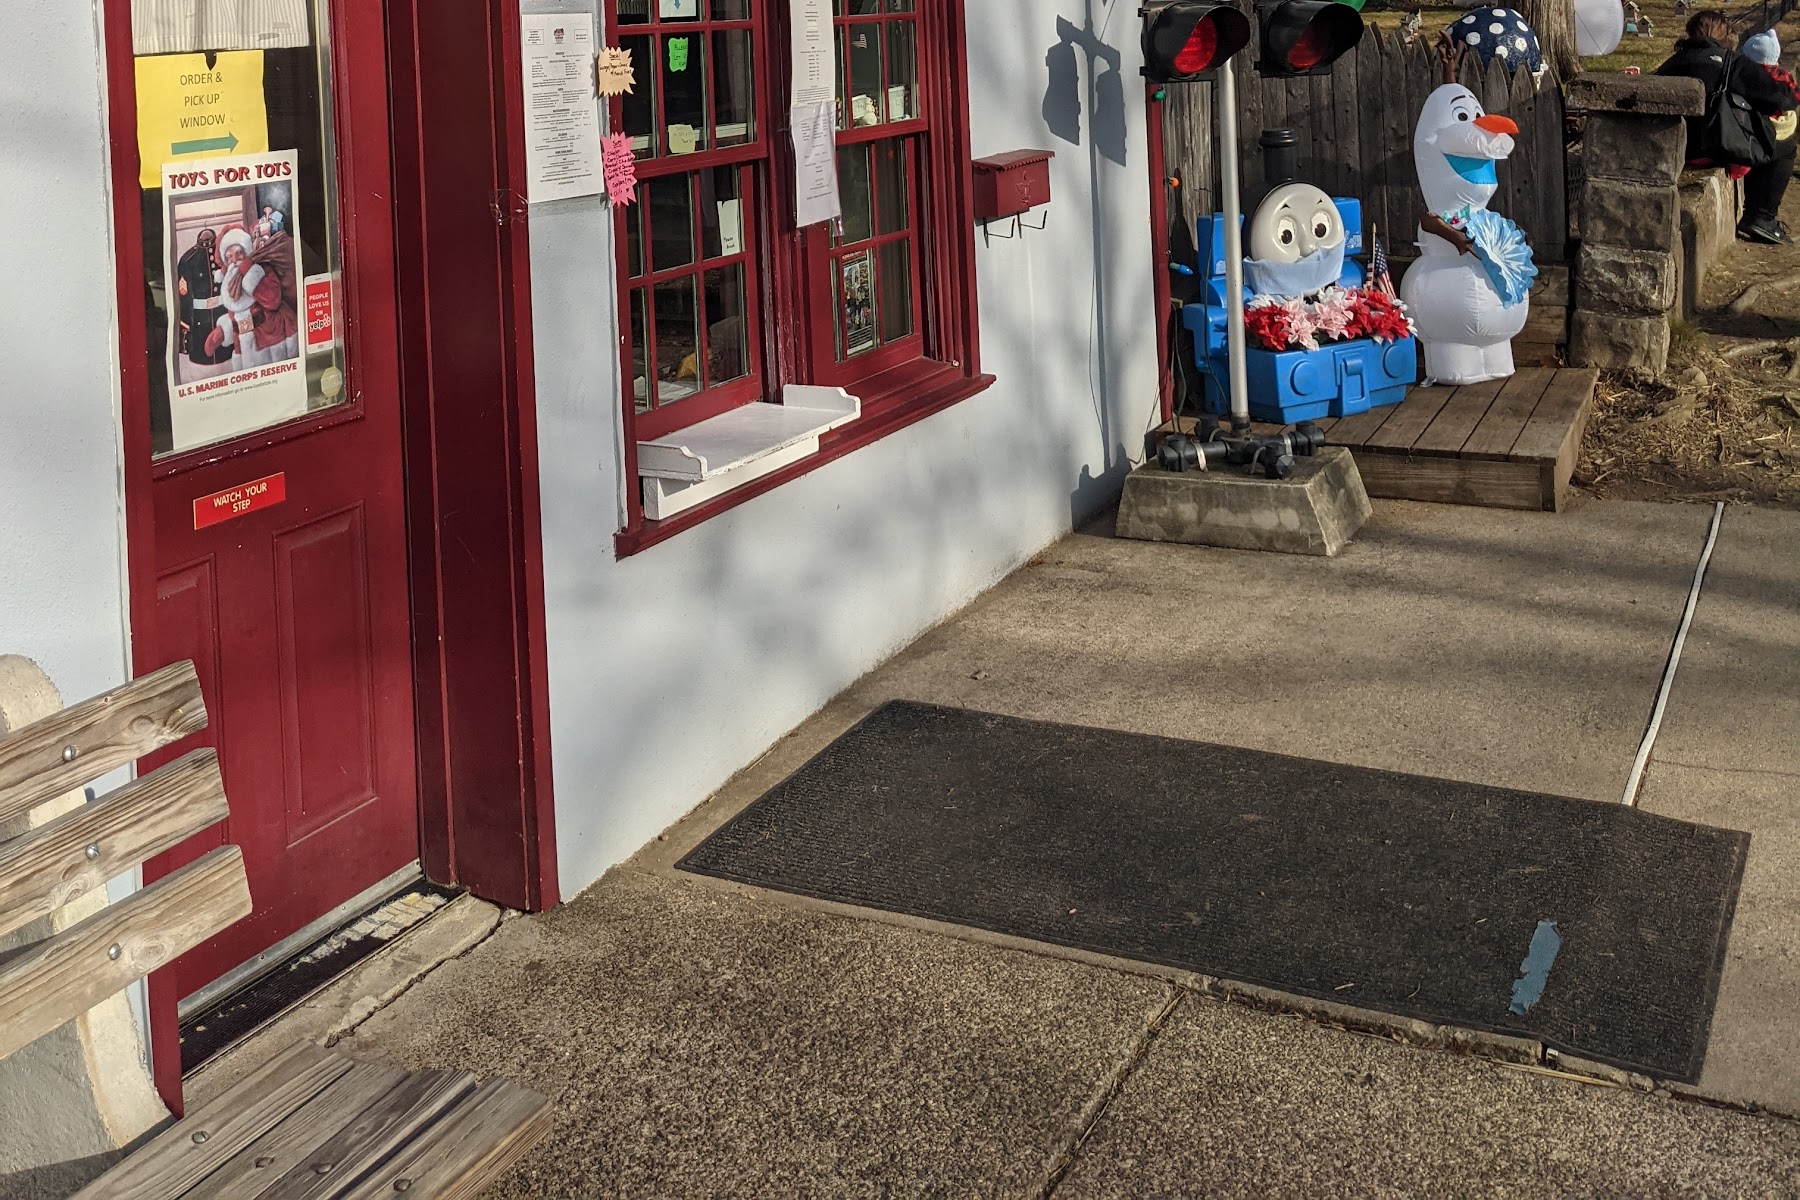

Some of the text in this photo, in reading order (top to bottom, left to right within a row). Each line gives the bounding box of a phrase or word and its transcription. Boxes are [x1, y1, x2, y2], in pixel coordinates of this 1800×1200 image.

[180, 71, 223, 86] ORDER &
[184, 93, 220, 107] PICK UP
[179, 114, 226, 129] WINDOW
[168, 161, 292, 189] TOYS FOR TOTS
[309, 292, 329, 301] PEOPLE
[309, 320, 325, 332] yelp
[195, 378, 229, 393] MARINE
[230, 371, 258, 384] CORPS
[260, 362, 298, 378] RESERVE
[215, 389, 234, 398] information
[213, 482, 267, 508] WATCH YOUR
[232, 499, 251, 513] STEP
